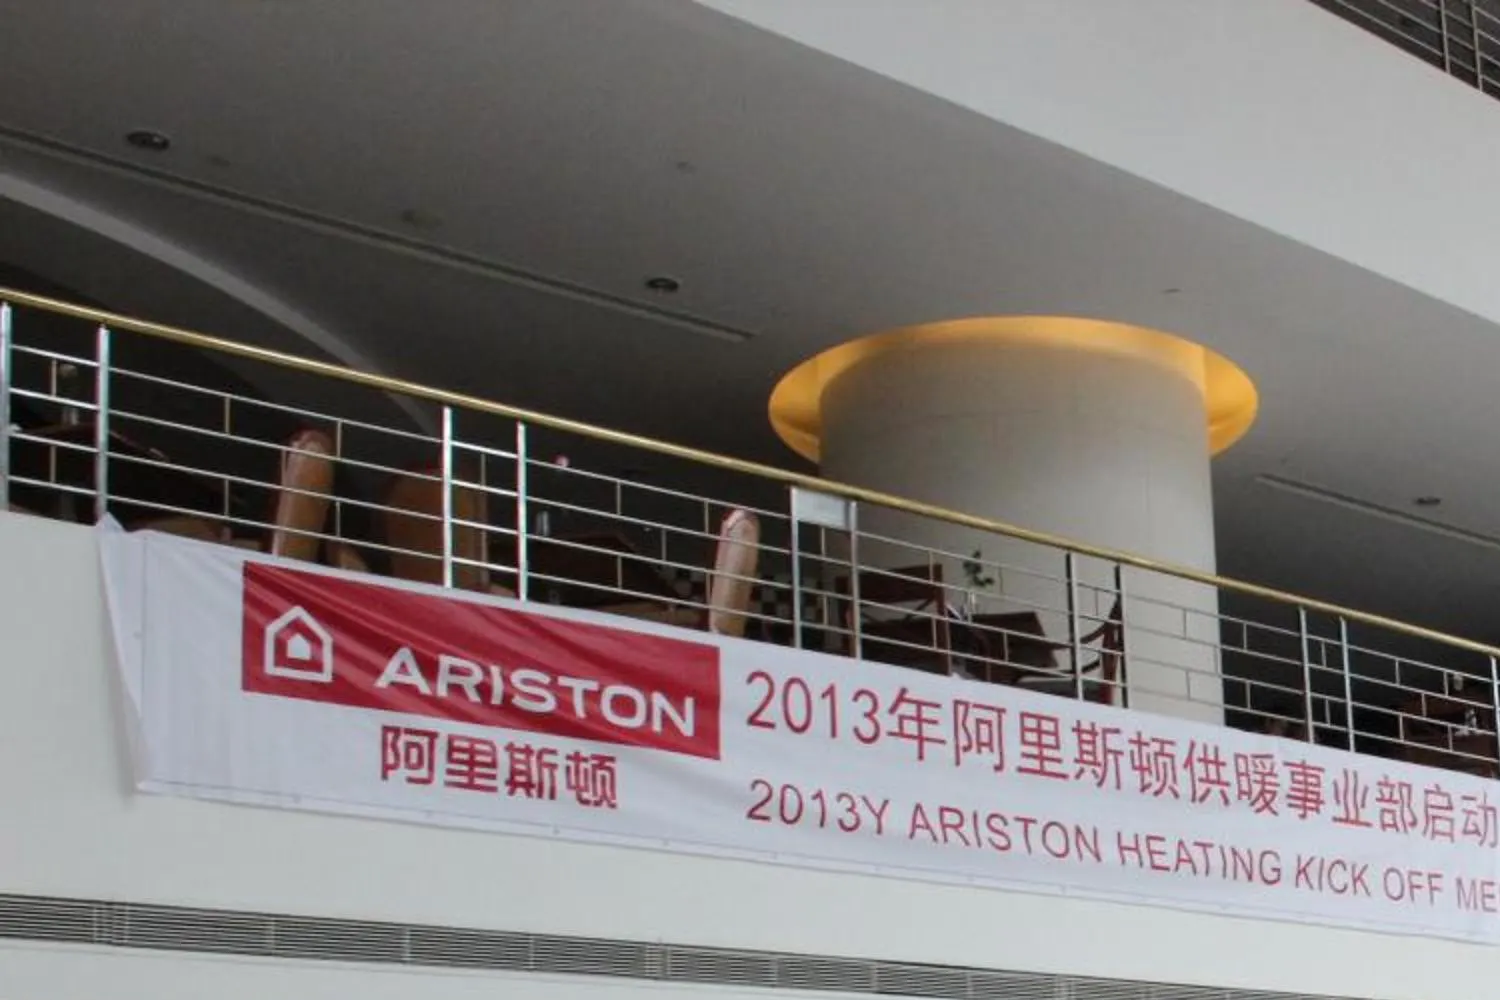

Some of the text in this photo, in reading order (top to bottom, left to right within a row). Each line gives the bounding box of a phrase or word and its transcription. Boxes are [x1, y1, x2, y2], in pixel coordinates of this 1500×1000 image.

[375, 646, 696, 738] ARISTON
[380, 724, 619, 809] 阿里斯顿
[745, 778, 890, 836] 2013Y
[908, 802, 1103, 864] ARISTON
[1116, 830, 1283, 886] HEATING
[1294, 854, 1372, 898] KICK
[1382, 866, 1444, 907] OFF
